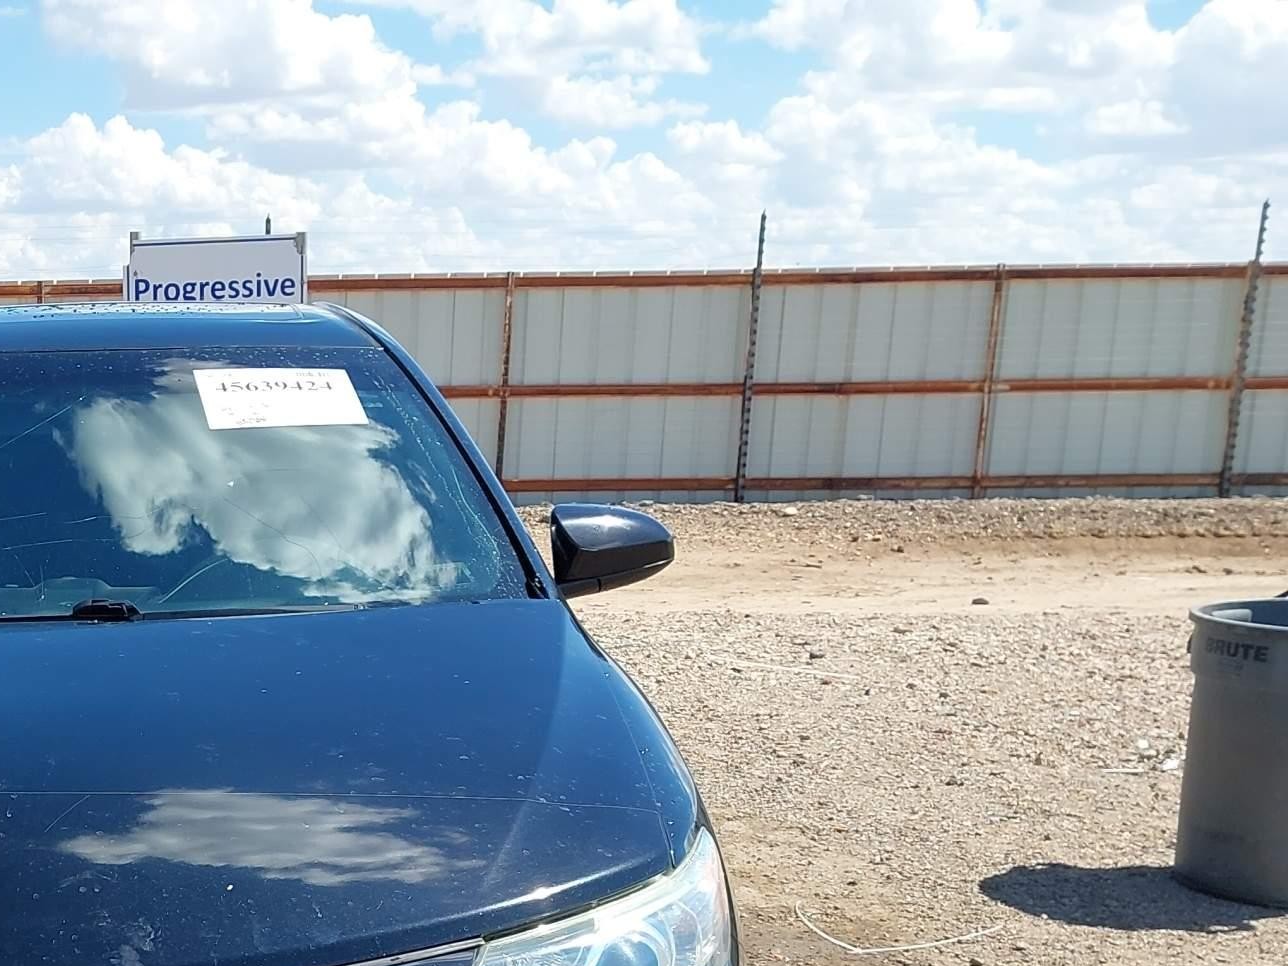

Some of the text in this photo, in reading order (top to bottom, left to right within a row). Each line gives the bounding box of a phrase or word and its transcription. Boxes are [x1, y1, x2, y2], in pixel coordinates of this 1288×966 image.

[134, 272, 296, 300] Progressive
[215, 380, 333, 393] 45639424
[1207, 638, 1269, 663] BRUTE
